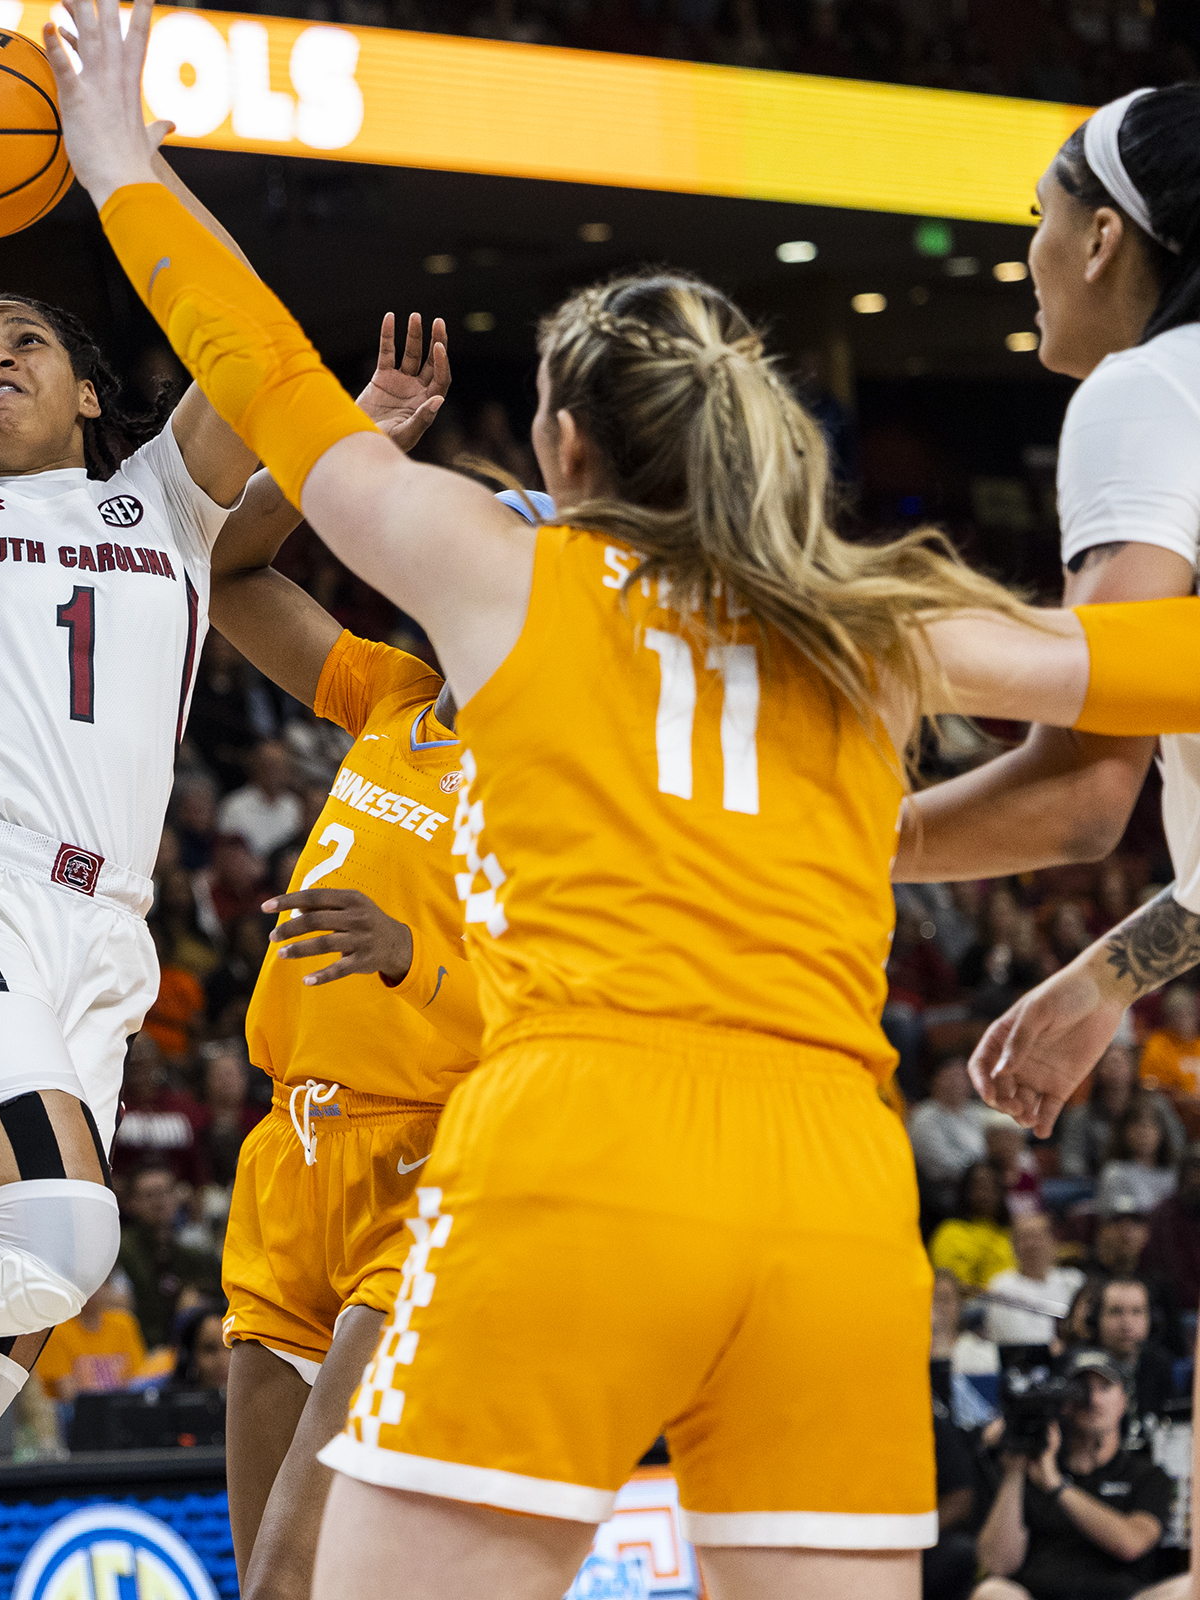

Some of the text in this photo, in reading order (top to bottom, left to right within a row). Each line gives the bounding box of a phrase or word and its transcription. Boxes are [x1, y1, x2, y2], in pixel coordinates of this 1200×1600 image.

[50, 4, 365, 150] OLS
[100, 496, 140, 525] SEC
[57, 542, 177, 582] CAROLINA
[56, 585, 95, 725] 1
[643, 626, 760, 815] 11
[328, 767, 450, 842] ENNESSEE
[290, 822, 355, 918] 2
